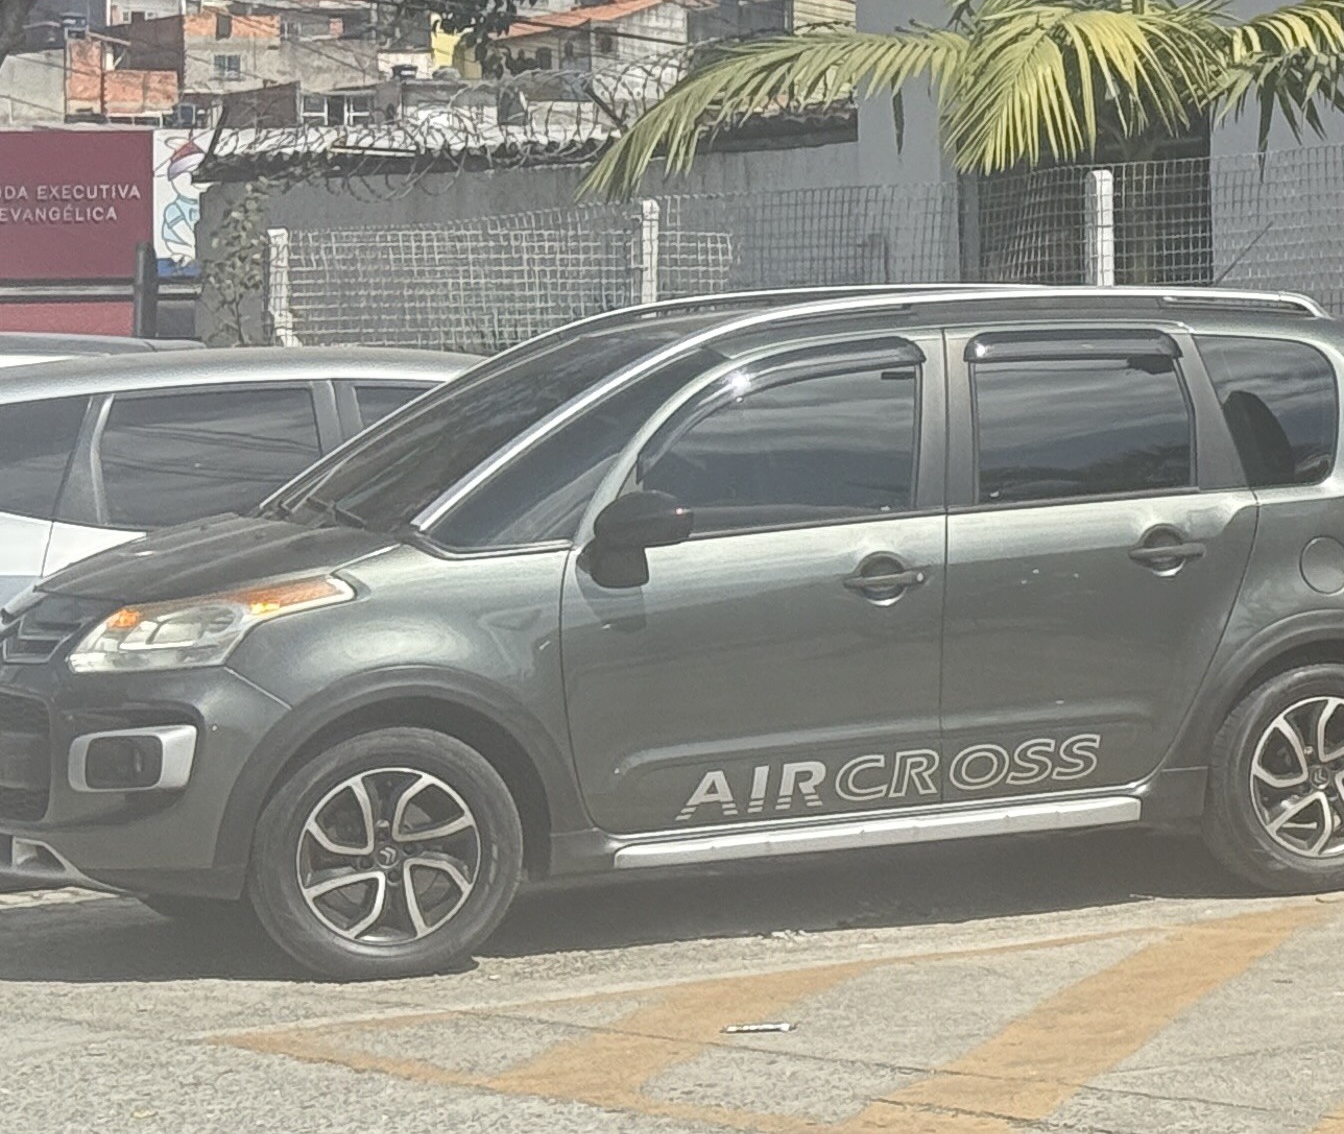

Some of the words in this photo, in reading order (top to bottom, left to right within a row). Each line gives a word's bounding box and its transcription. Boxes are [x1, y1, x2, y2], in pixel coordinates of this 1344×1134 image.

[37, 184, 141, 201] EXECUTIVA
[0, 204, 118, 222] EVANGÉLICA
[675, 733, 1101, 822] AIRCROSS
